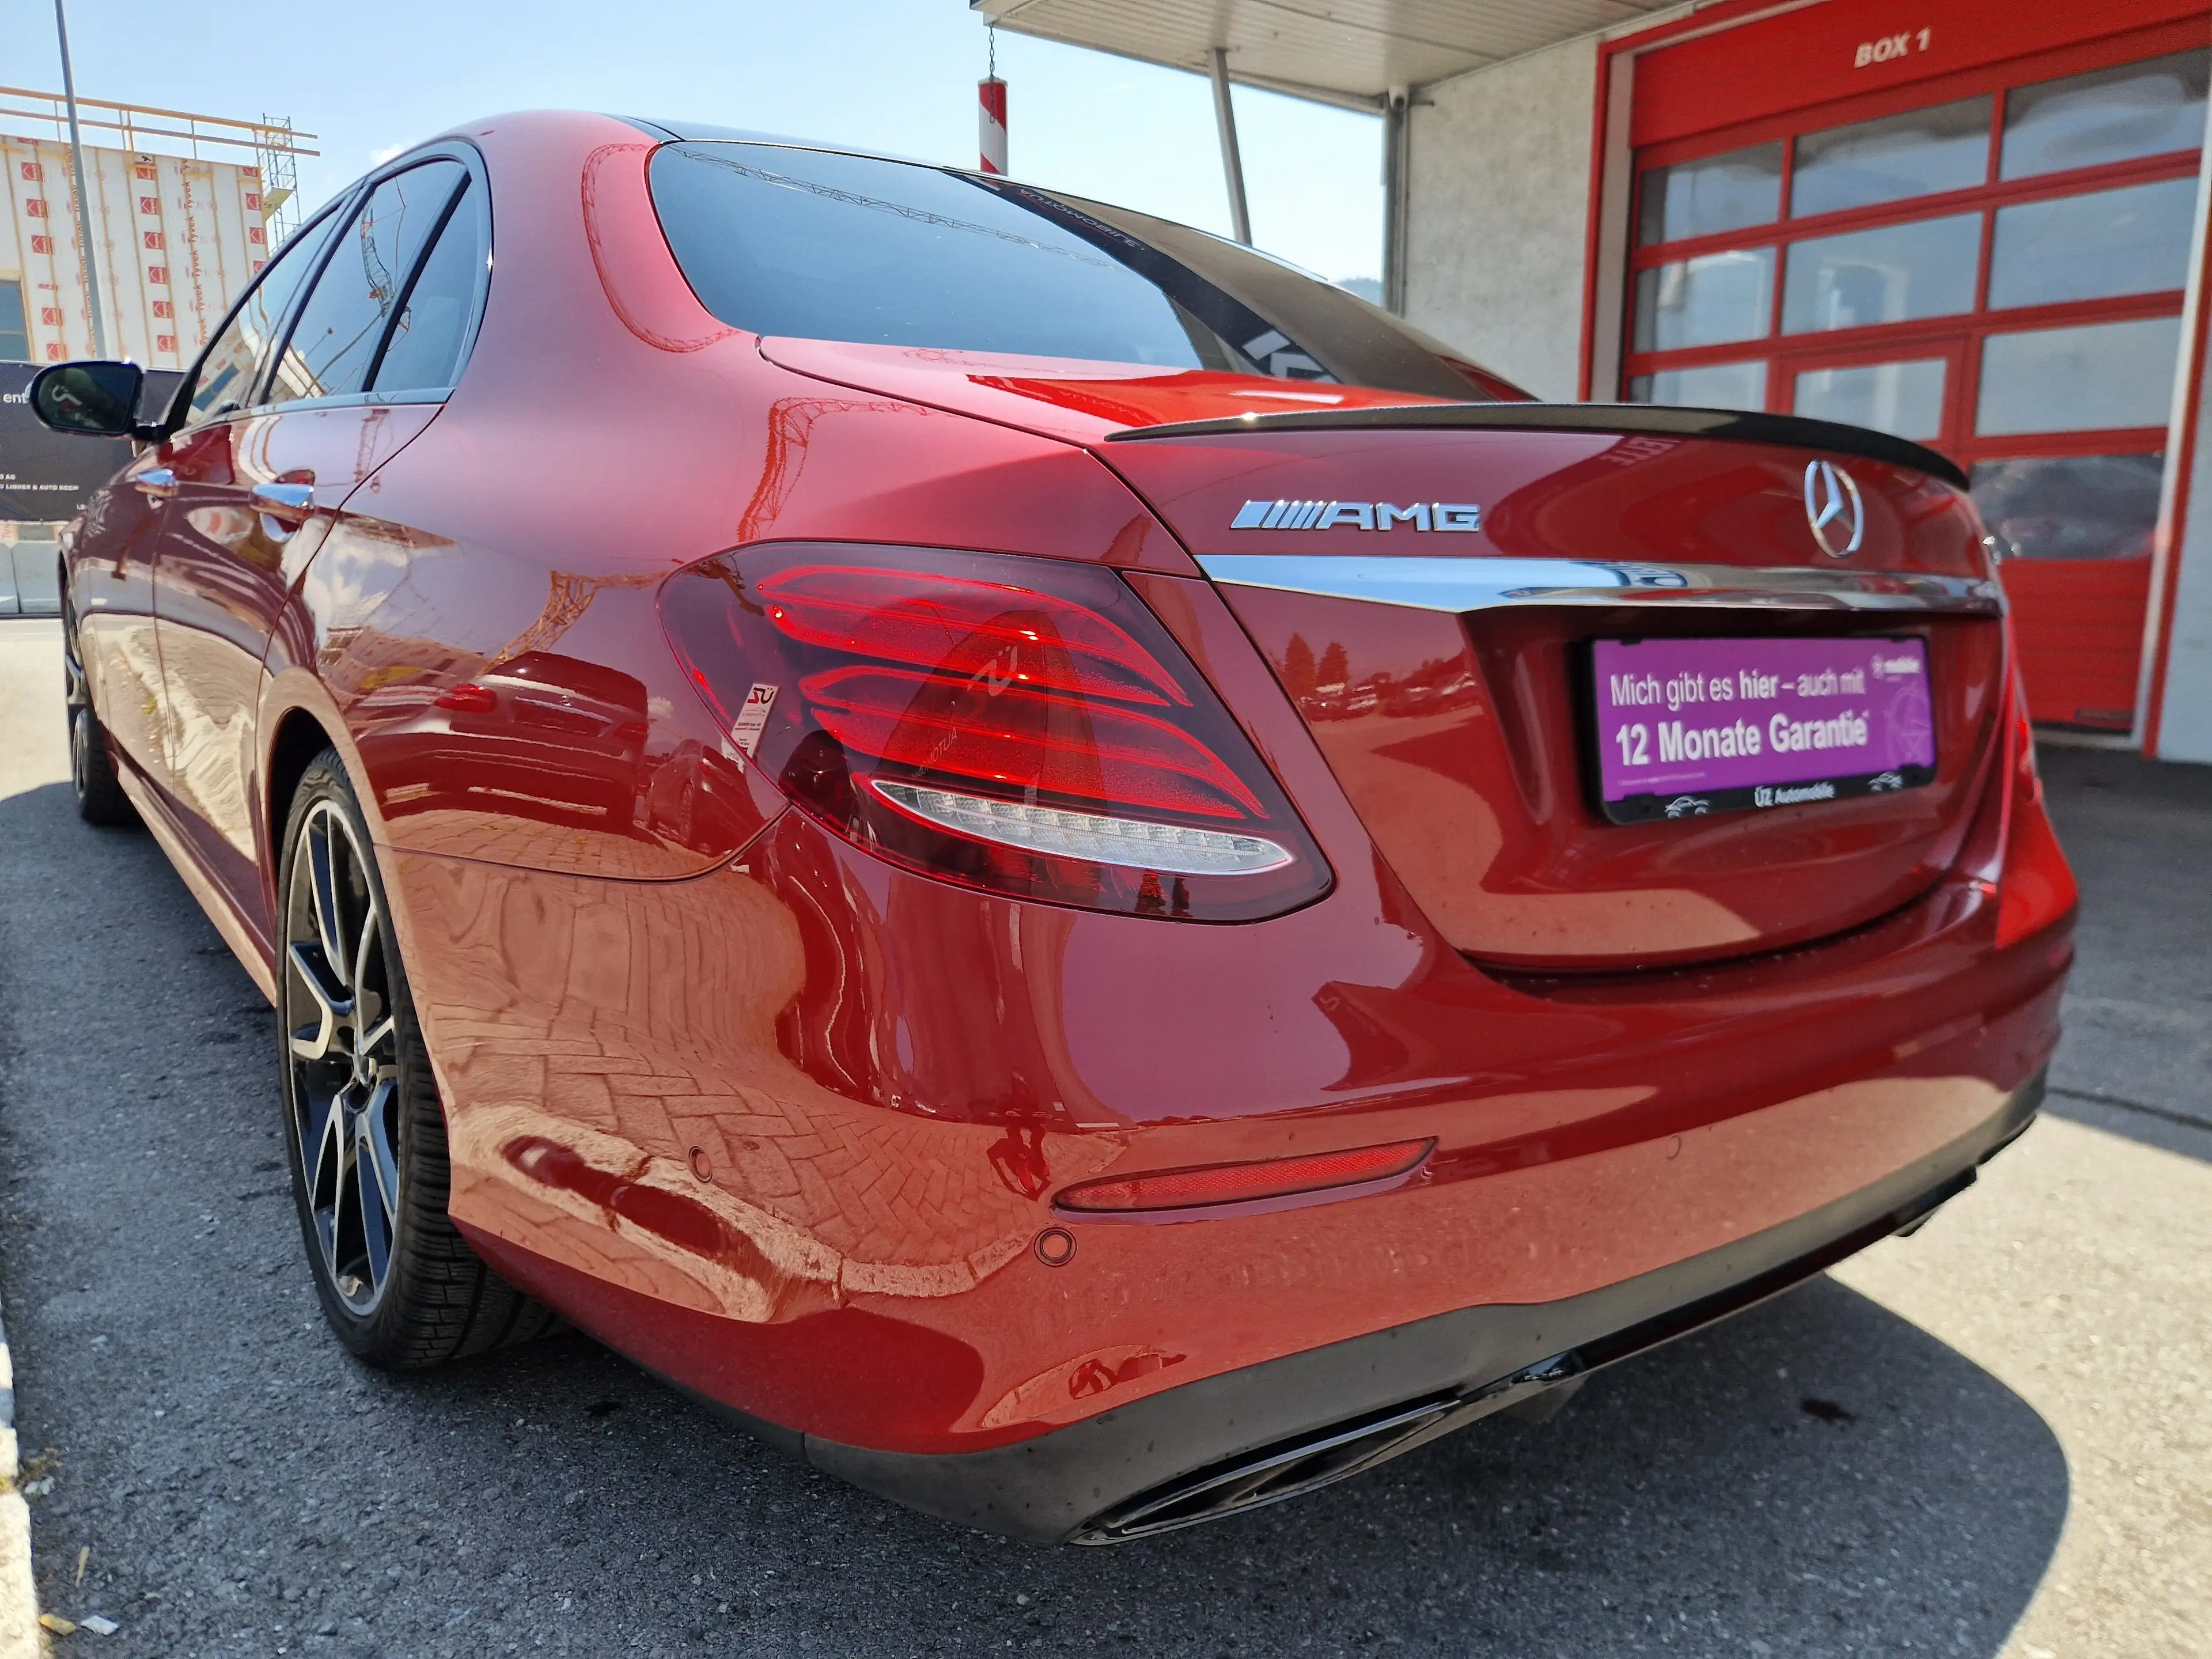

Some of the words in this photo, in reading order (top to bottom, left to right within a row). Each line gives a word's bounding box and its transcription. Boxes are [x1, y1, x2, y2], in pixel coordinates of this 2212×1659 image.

[1854, 31, 1911, 68] BOX
[1916, 26, 1932, 52] 1
[187, 217, 199, 243] Tyvek
[191, 251, 202, 277] Tyvek
[1315, 501, 1480, 532] AMG
[1610, 672, 1660, 706] Mich
[1666, 671, 1705, 711] gibt
[1709, 676, 1733, 700] es
[1739, 669, 1778, 699] hier
[1797, 668, 1839, 698] auch
[1840, 667, 1866, 695] mit
[1616, 723, 1650, 766] 12
[1658, 718, 1760, 763] Monate
[1755, 785, 1774, 808] ÜZ
[1774, 781, 1836, 805] Automobile
